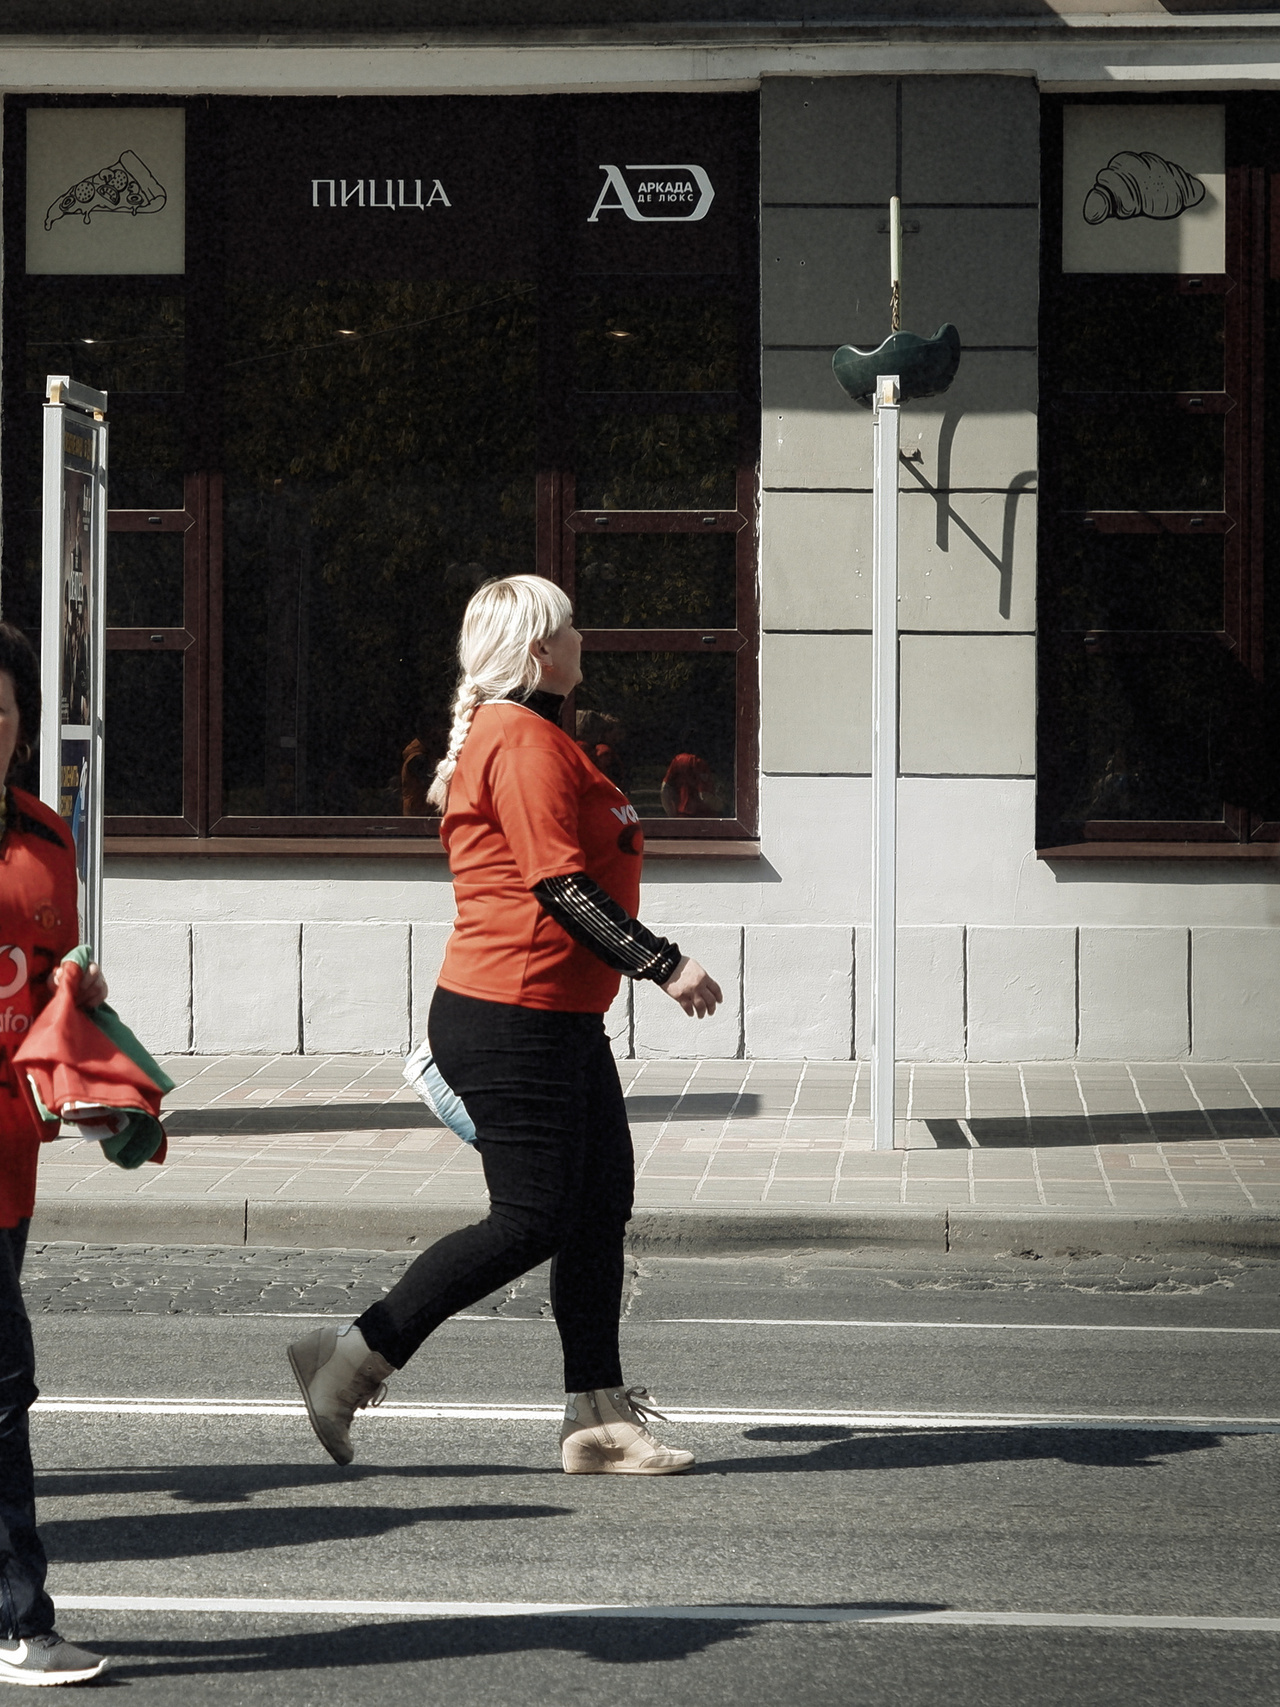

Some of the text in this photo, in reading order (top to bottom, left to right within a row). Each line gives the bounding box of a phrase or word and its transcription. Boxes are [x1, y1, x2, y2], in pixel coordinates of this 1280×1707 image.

[637, 181, 693, 194] АРКАДА
[311, 179, 452, 211] ПИЦЦА
[637, 193, 694, 203] ДЕ ЛЮКС
